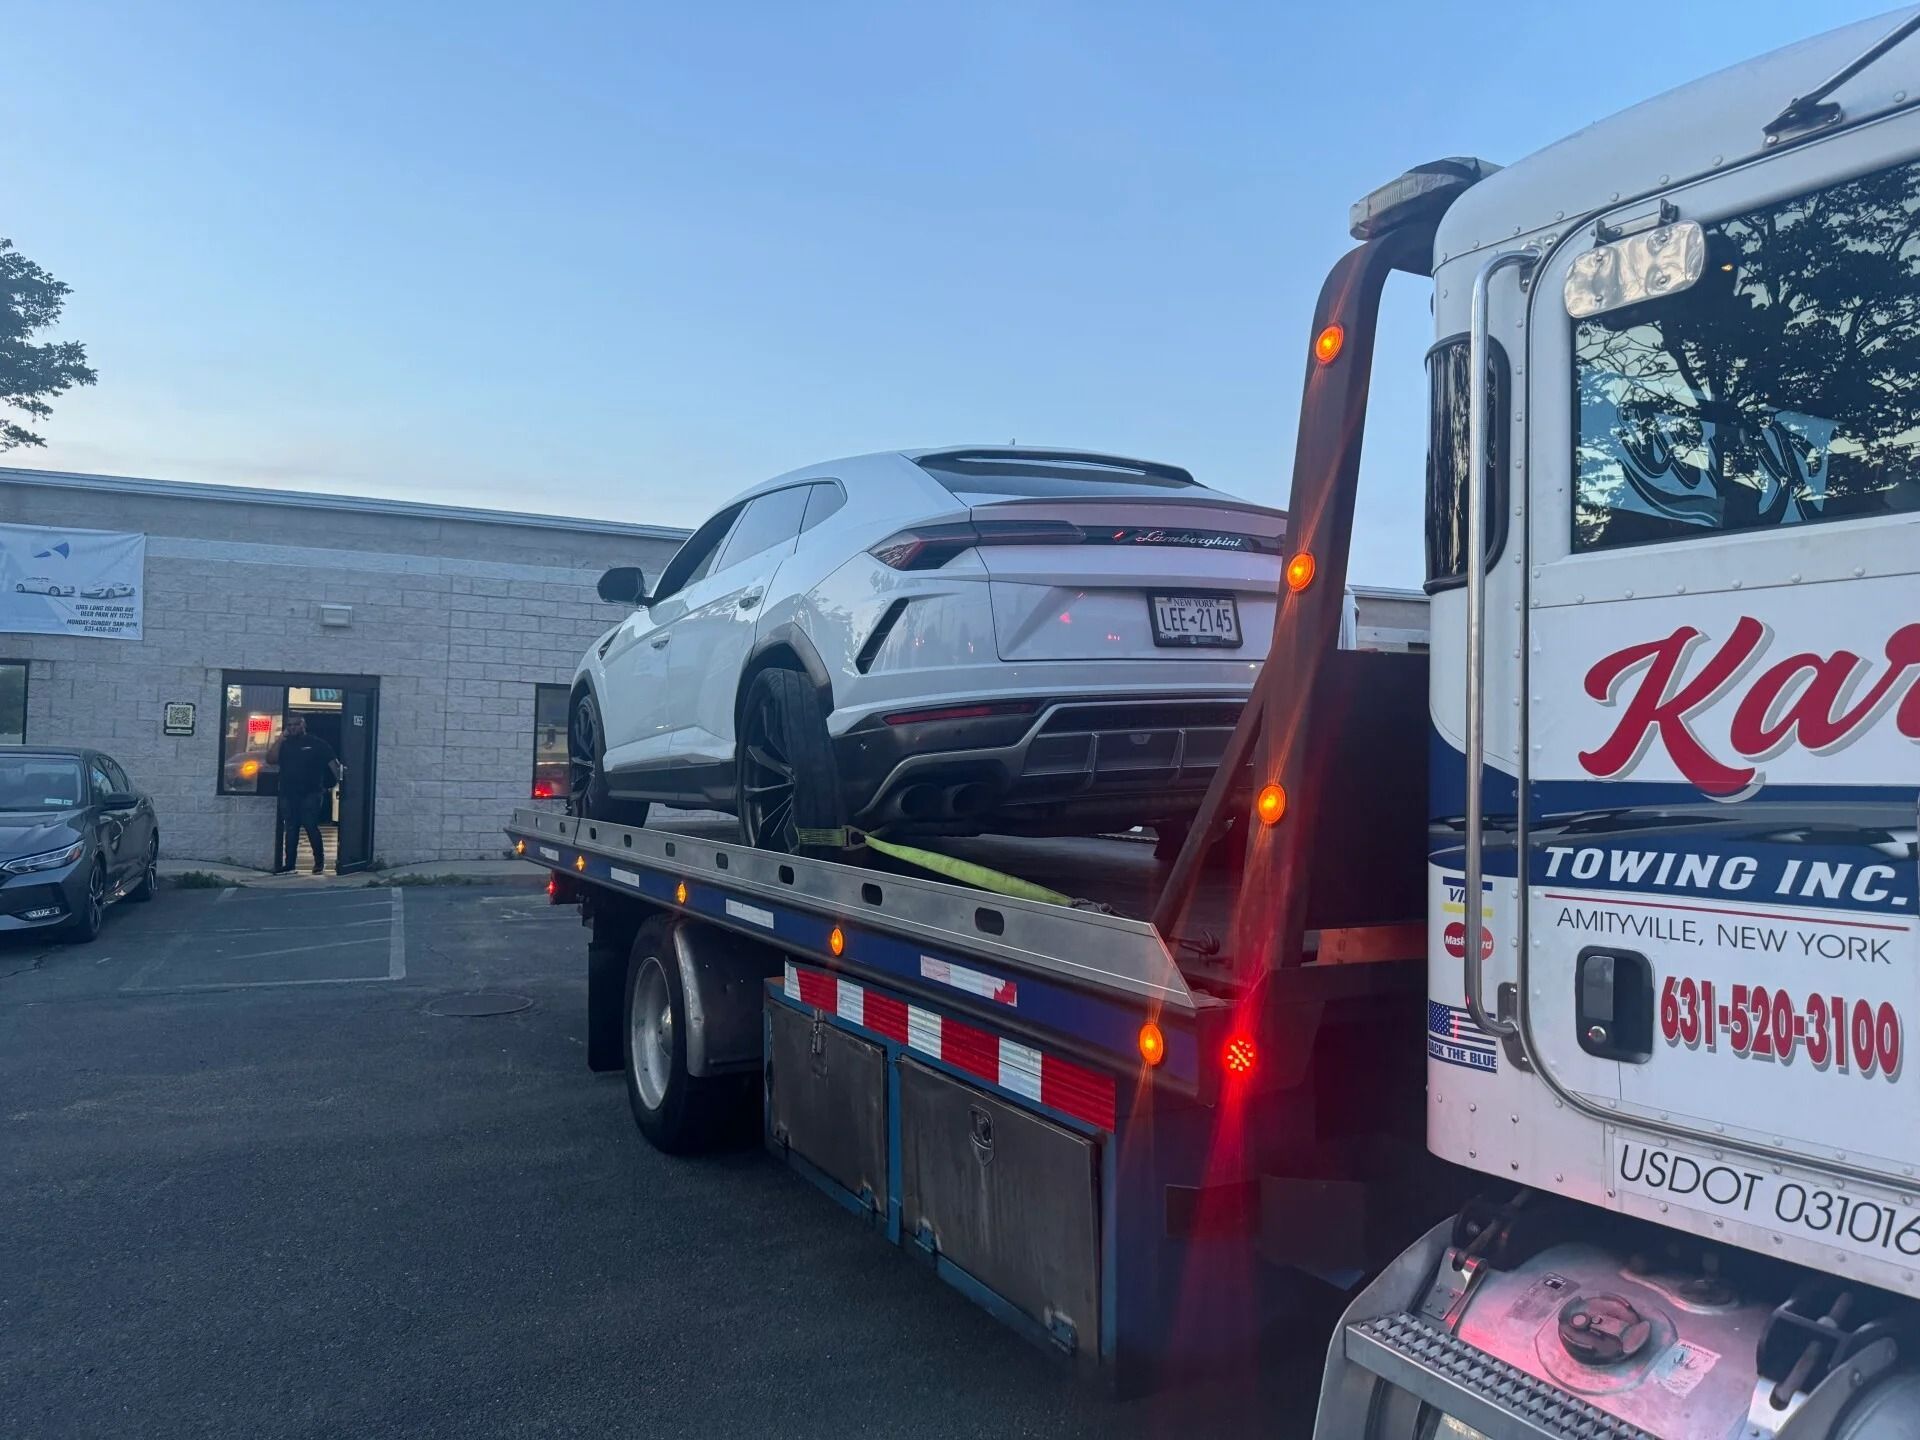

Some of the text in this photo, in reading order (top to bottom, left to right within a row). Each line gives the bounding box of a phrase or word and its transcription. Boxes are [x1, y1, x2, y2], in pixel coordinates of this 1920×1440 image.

[1136, 530, 1242, 547] Lamborghini
[1160, 607, 1233, 633] LEE 2145
[1174, 599, 1215, 608] NEW YORK
[1545, 847, 1908, 906] TOWING INC.
[1557, 907, 1892, 965] AMITYVILLE, NEW YORK
[1660, 975, 1902, 1081] 631-520-3100
[1446, 1047, 1466, 1062] THE
[1470, 1052, 1497, 1068] BLUE
[1620, 1144, 1764, 1211] USDOT
